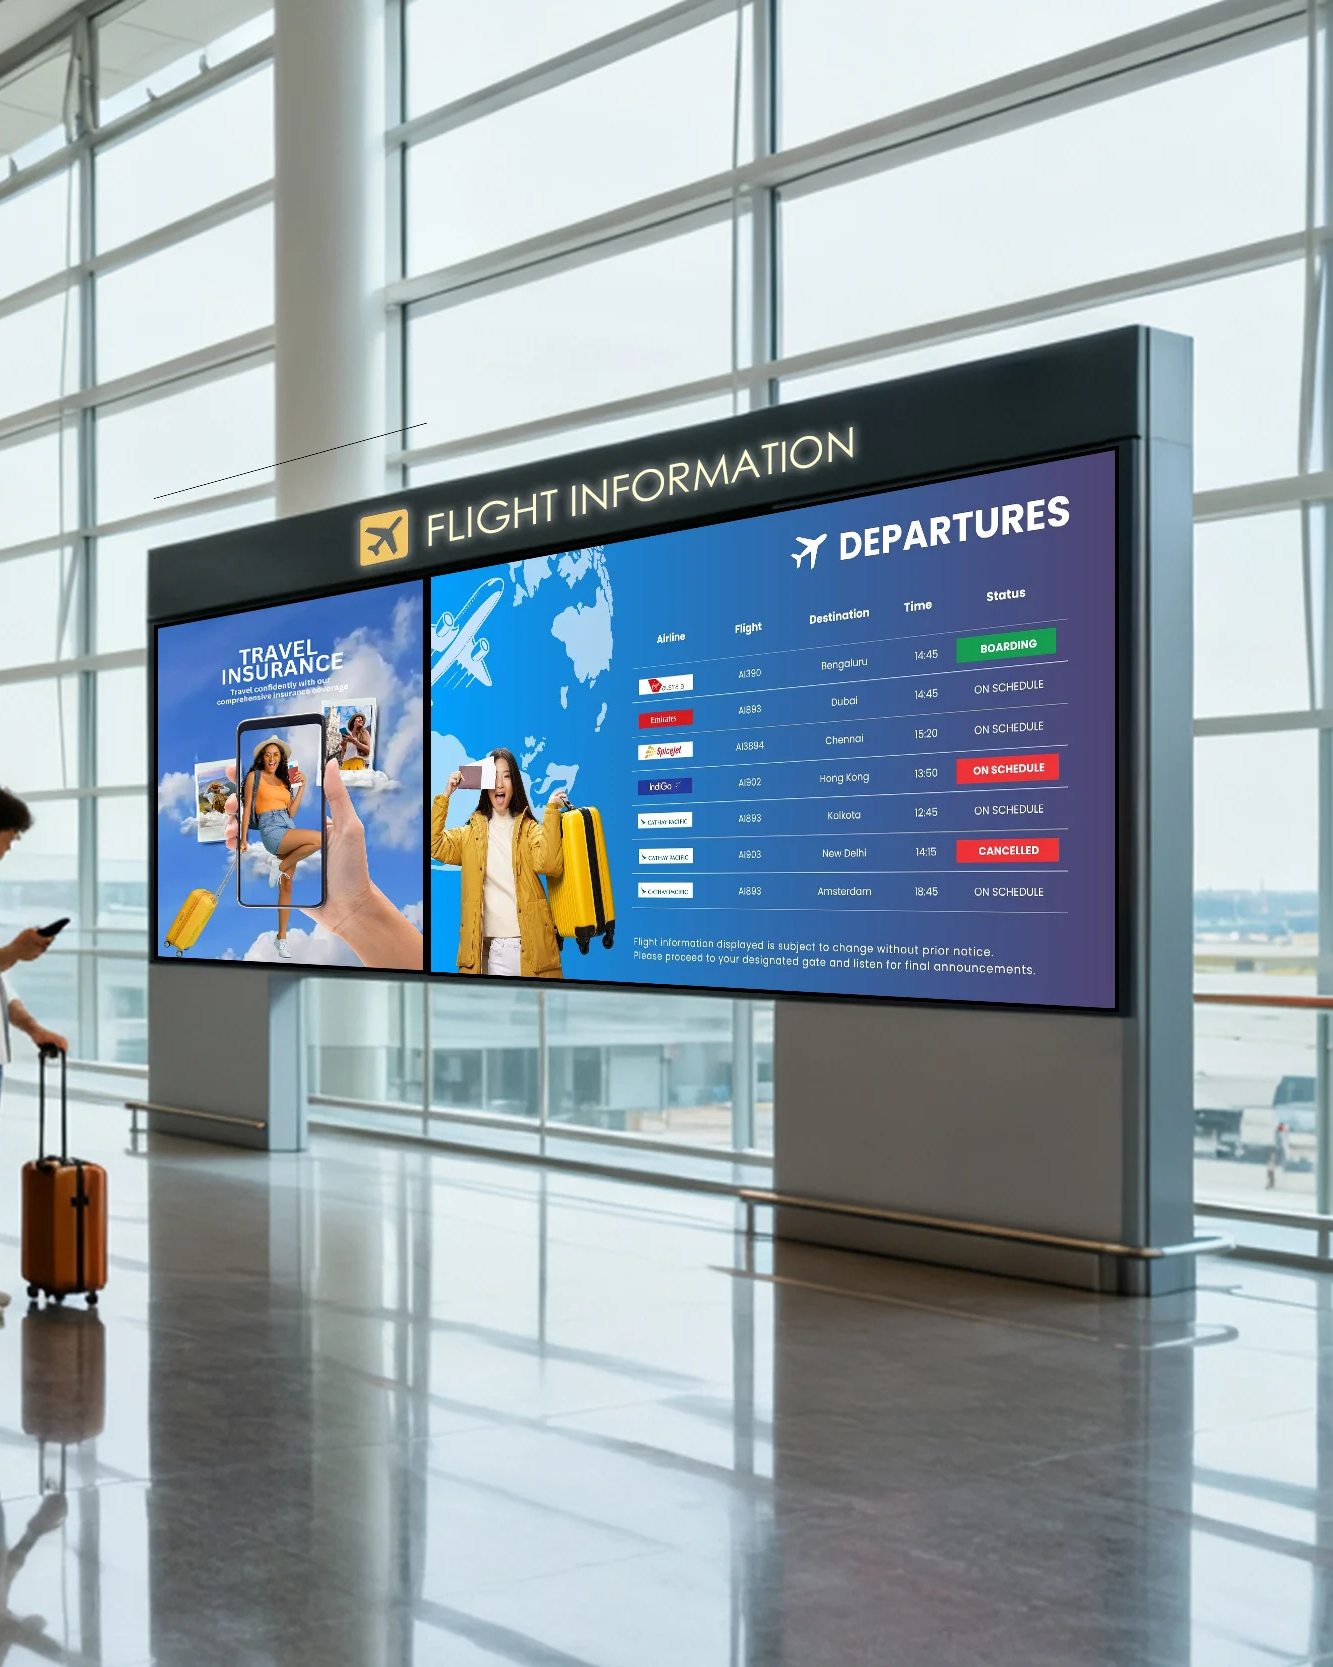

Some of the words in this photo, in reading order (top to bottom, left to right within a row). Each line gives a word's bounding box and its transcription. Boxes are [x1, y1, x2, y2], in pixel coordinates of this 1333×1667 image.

[426, 488, 559, 548] FLIGHT
[570, 426, 855, 518] INFORMATION
[838, 495, 1071, 562] DEPARTURES
[986, 589, 1026, 602] Status
[903, 600, 933, 613] Time
[809, 608, 870, 625] Destination
[734, 621, 763, 636] Flight
[656, 632, 686, 644] Airline
[239, 639, 318, 665] TRAVEL
[980, 638, 1038, 654] BOARDING
[914, 649, 939, 661] 14:45
[222, 652, 344, 685] INSURANCE
[821, 658, 868, 672] Bengaluru
[738, 668, 762, 679] AI390
[230, 687, 253, 696] Travel
[254, 681, 297, 693] confidently
[298, 679, 316, 688] with
[317, 677, 332, 685] our
[973, 684, 990, 695] ON
[992, 679, 1044, 693] SCHEDULE
[217, 693, 272, 706] comprehensive
[273, 688, 310, 699] insurance
[311, 683, 349, 693] coverage
[914, 688, 939, 700] 14:45
[831, 696, 858, 707] Dubai
[738, 704, 762, 715] AI893
[650, 716, 677, 724] Emirates
[914, 728, 938, 739] 15:20
[974, 724, 990, 735] ON
[992, 720, 1044, 734] SCHEDULE
[825, 735, 864, 745] Chennai
[914, 768, 938, 779] 13:50
[973, 765, 990, 777] ON
[991, 762, 1045, 775] SCHEDULE
[738, 777, 762, 787] AI902
[819, 774, 844, 785] Hong
[845, 772, 870, 784] Kong
[914, 807, 938, 818] 12:45
[974, 805, 990, 816] ON
[992, 804, 1044, 815] SCHEDULE
[738, 813, 762, 823] AI893
[738, 849, 762, 859] AI903
[822, 849, 842, 858] New
[844, 847, 867, 858] Delhi
[915, 846, 937, 857] 14:15
[978, 845, 1040, 856] CANCELLED
[738, 886, 762, 896] AI893
[817, 886, 872, 896] Amsterdam
[914, 886, 939, 897] 18:45
[973, 887, 990, 897] ON
[992, 887, 1044, 897] SCHEDULE
[633, 937, 658, 949] Flight
[660, 937, 714, 948] information
[716, 939, 764, 952] displayed
[767, 942, 775, 950] is
[778, 942, 816, 954] subject
[818, 942, 830, 952] to
[832, 942, 874, 956] change
[876, 944, 919, 955] without
[922, 945, 950, 958] prior
[953, 947, 994, 957] notice.
[633, 950, 663, 961] Please
[665, 953, 703, 964] proceed
[705, 953, 716, 963] to
[718, 955, 740, 965] your
[742, 954, 799, 968] designated
[802, 957, 826, 969] gate
[829, 958, 850, 968] and
[853, 958, 883, 969] listen
[886, 959, 902, 970] for
[904, 959, 930, 971] final
[933, 963, 1036, 975] announcements.
